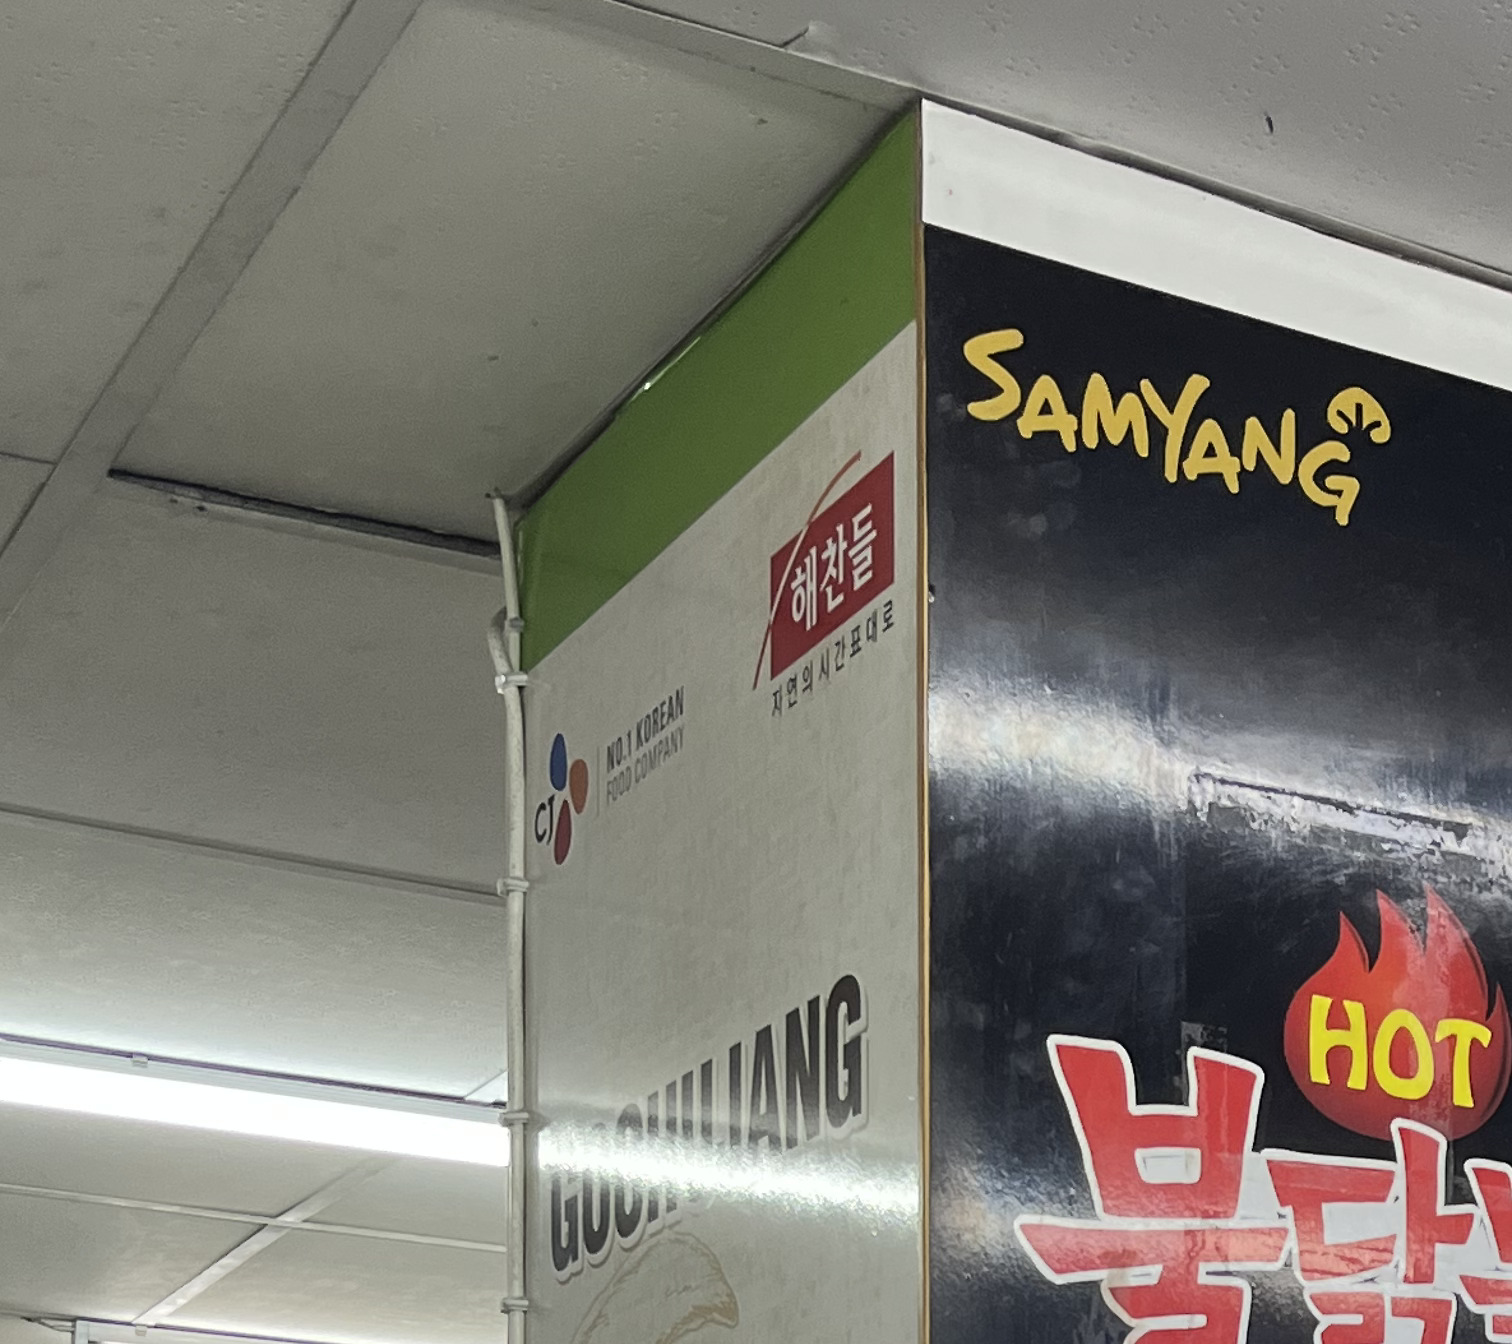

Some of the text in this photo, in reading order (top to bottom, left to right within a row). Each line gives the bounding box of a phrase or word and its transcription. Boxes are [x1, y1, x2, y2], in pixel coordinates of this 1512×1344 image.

[963, 328, 1361, 527] SAMYANG
[790, 503, 877, 631] 해찬들
[606, 685, 685, 774] NO.1 KOREAN
[606, 723, 685, 806] FOOD COMPANY
[534, 794, 556, 846] CJ
[1309, 995, 1493, 1108] HOT
